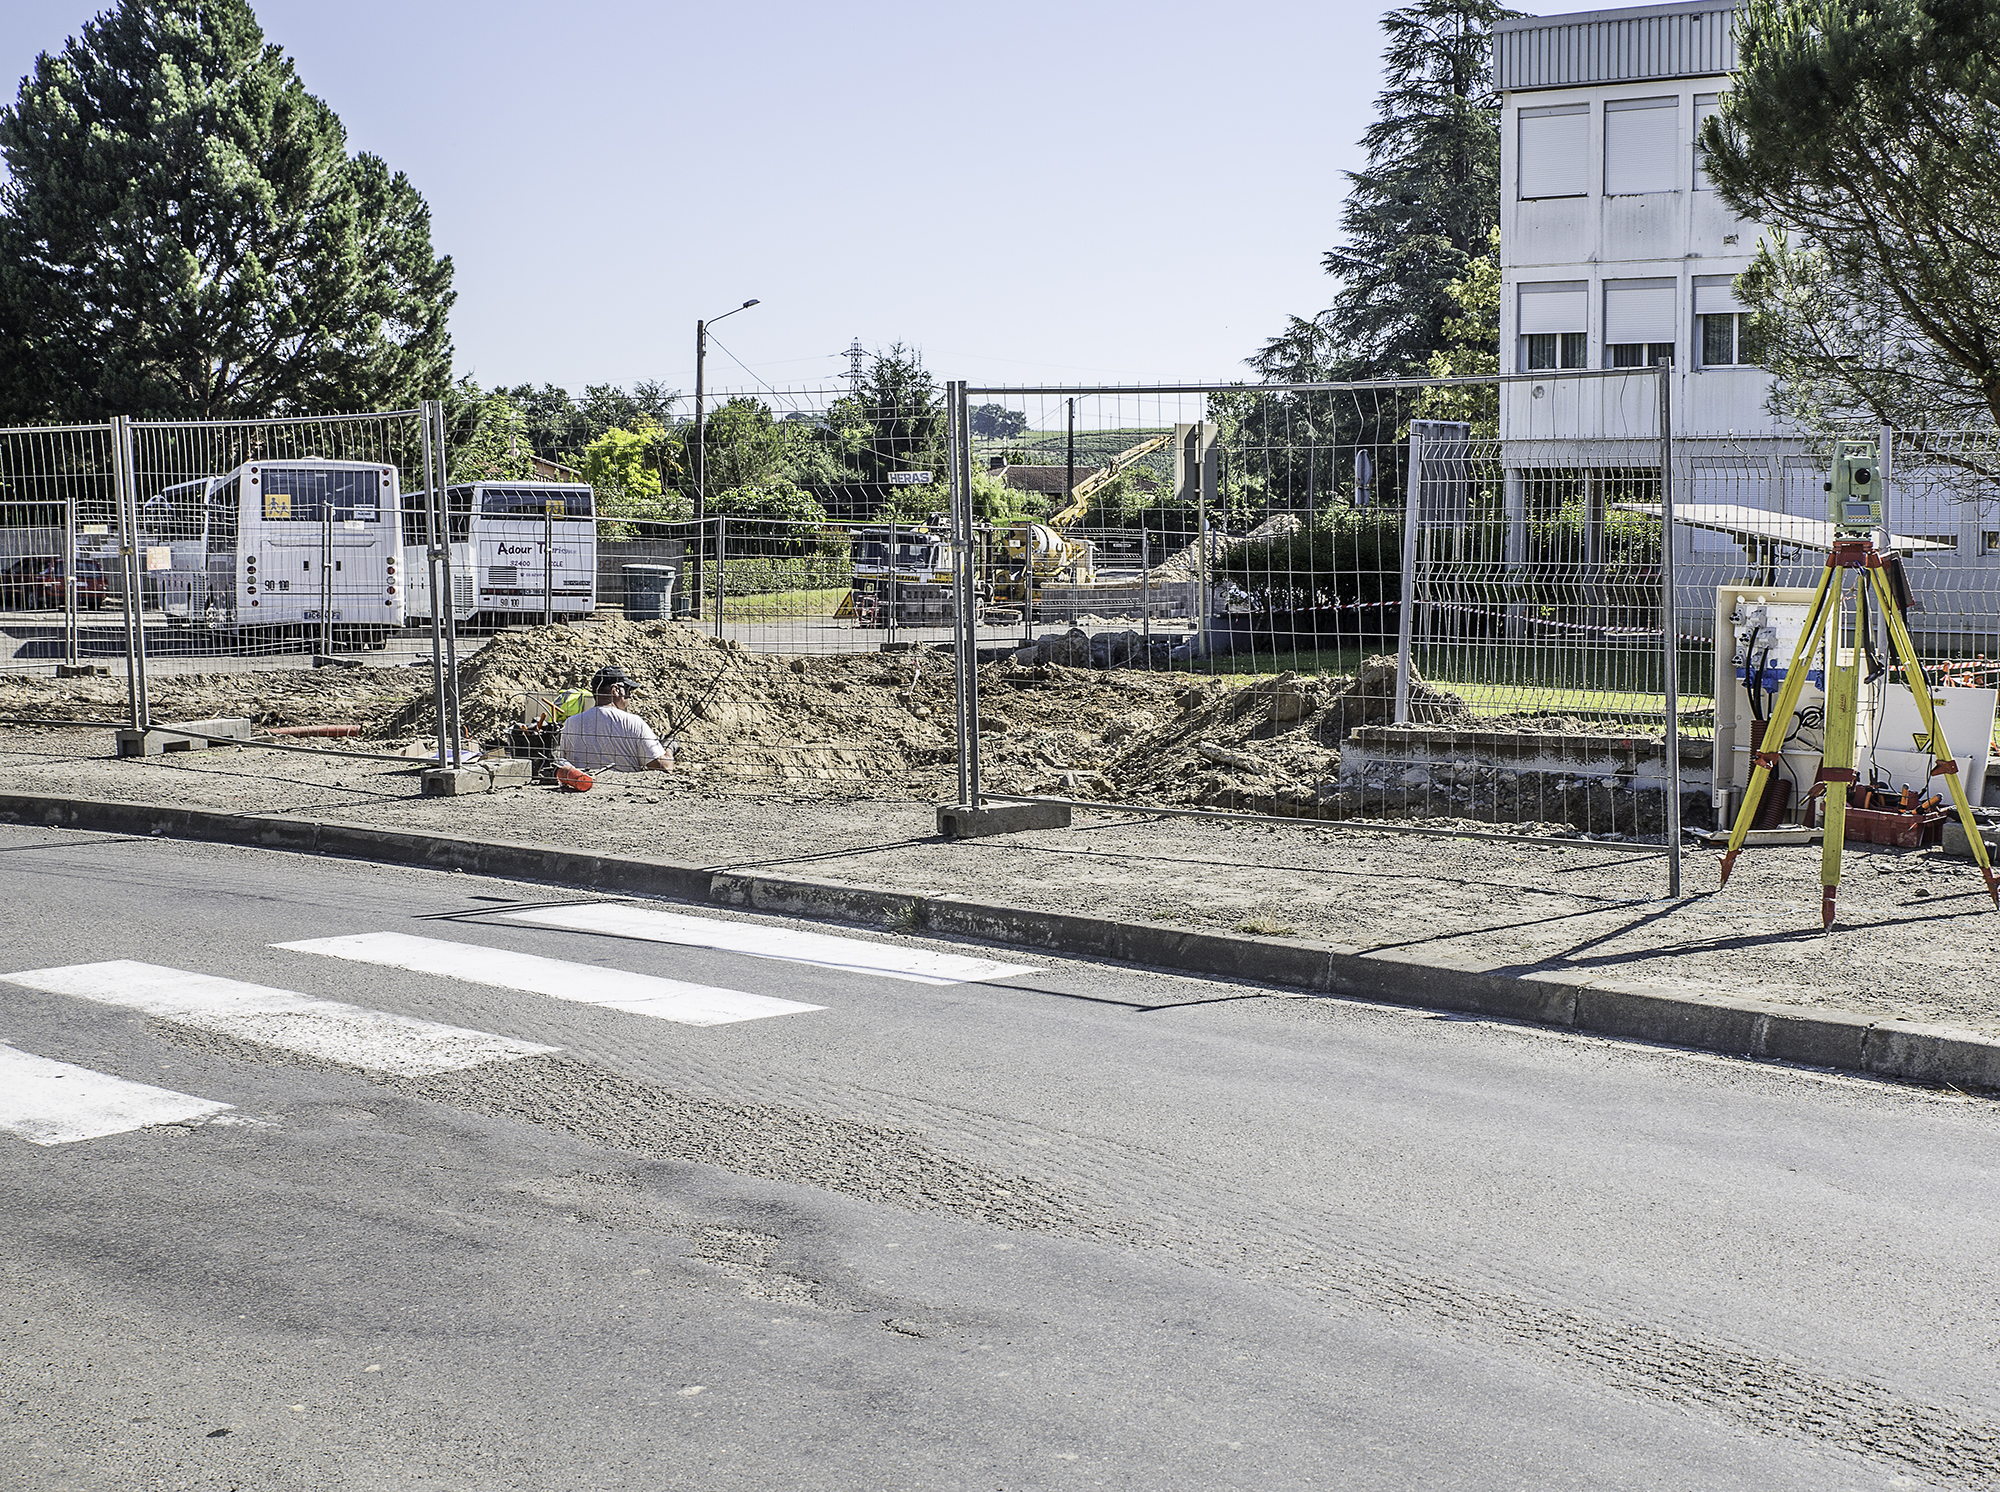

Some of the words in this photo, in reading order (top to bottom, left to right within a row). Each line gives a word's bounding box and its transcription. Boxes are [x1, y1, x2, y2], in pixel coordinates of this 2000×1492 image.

[890, 472, 930, 483] HERAS
[497, 542, 532, 555] Adour
[264, 580, 275, 591] 90
